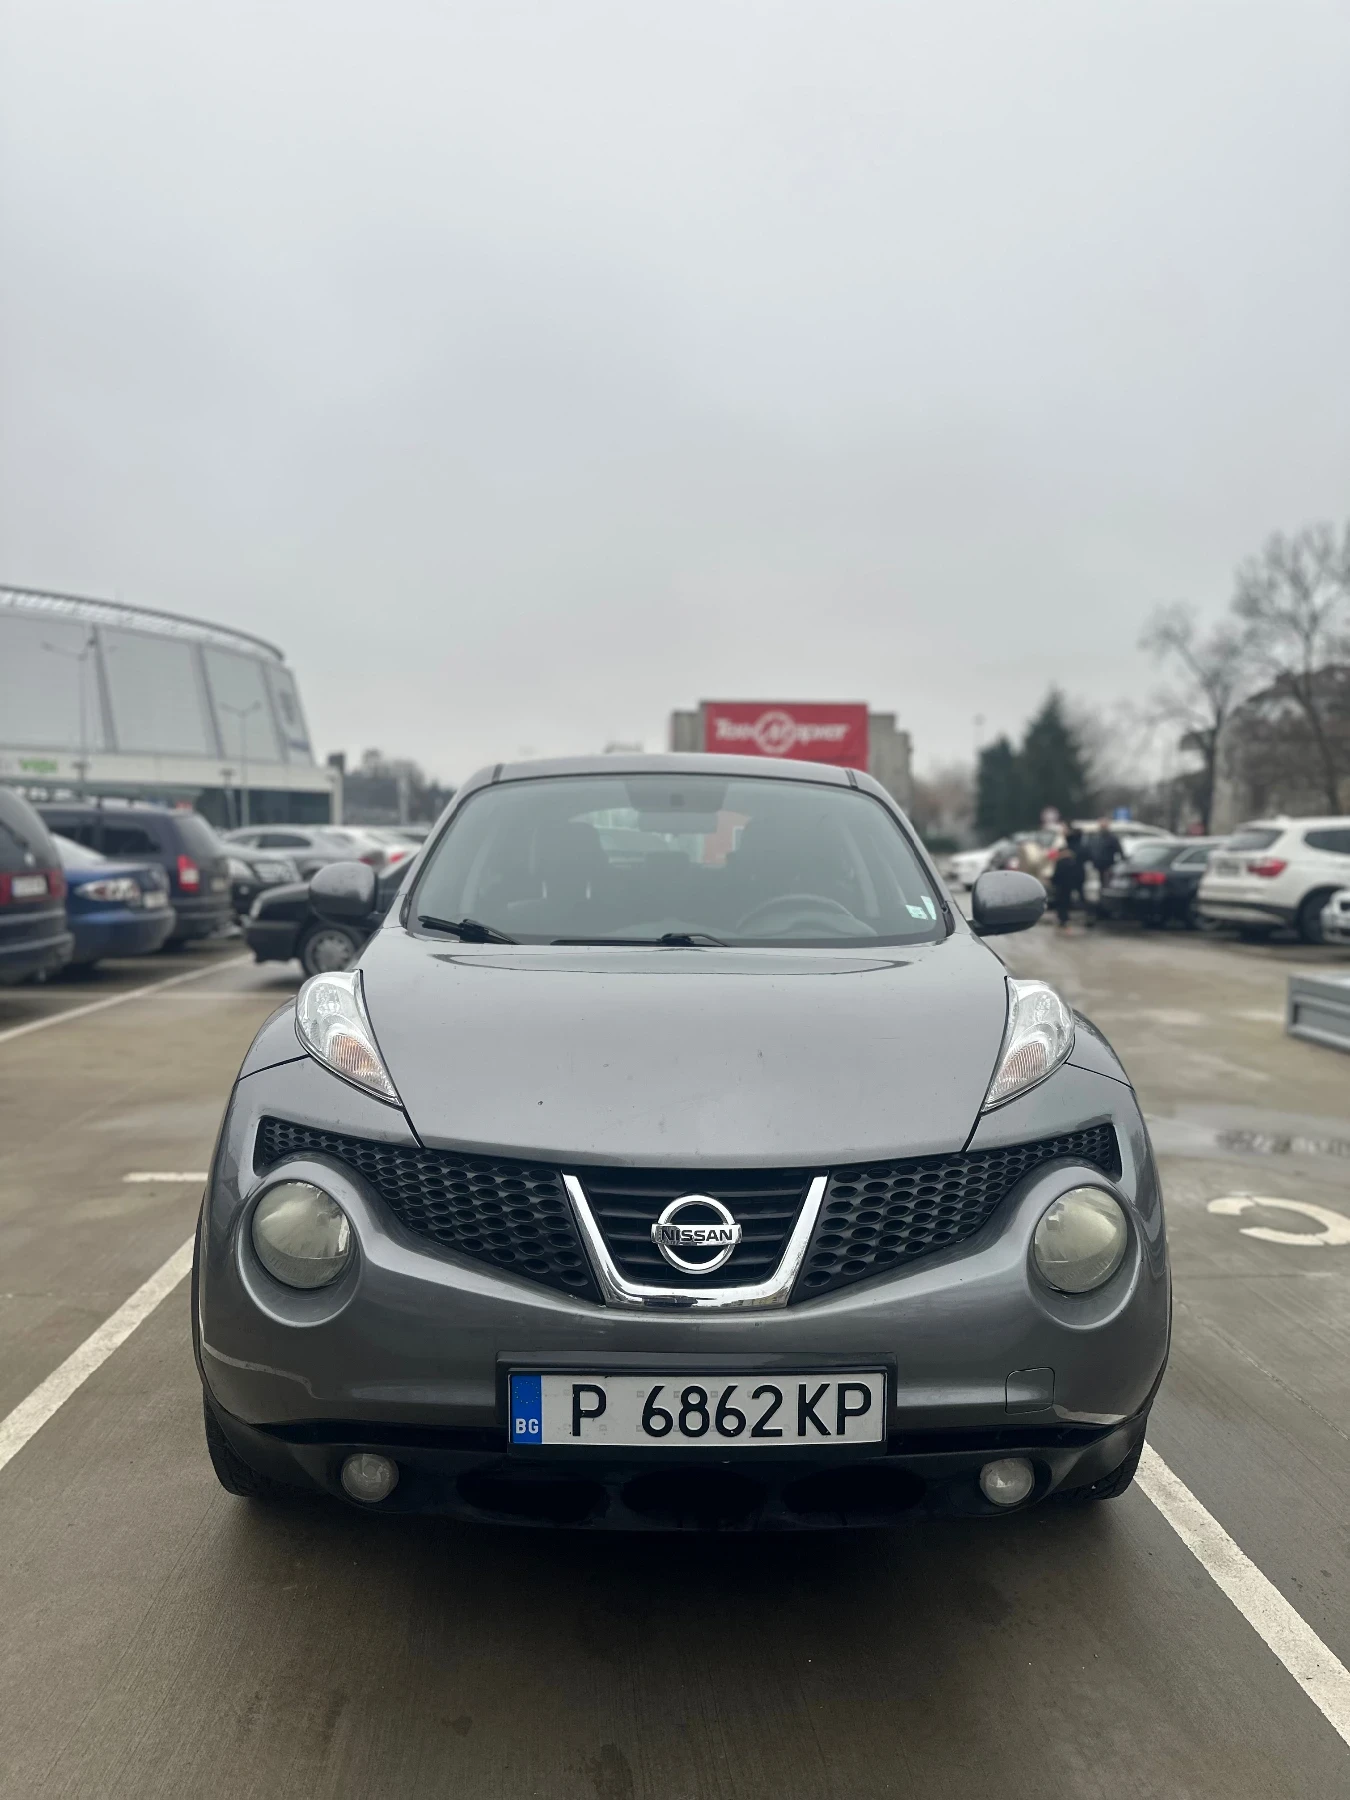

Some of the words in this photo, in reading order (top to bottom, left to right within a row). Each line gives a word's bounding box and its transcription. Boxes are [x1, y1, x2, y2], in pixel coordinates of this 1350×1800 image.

[661, 1229, 733, 1242] NISSAN
[571, 1383, 607, 1437] P
[515, 1418, 539, 1434] BG
